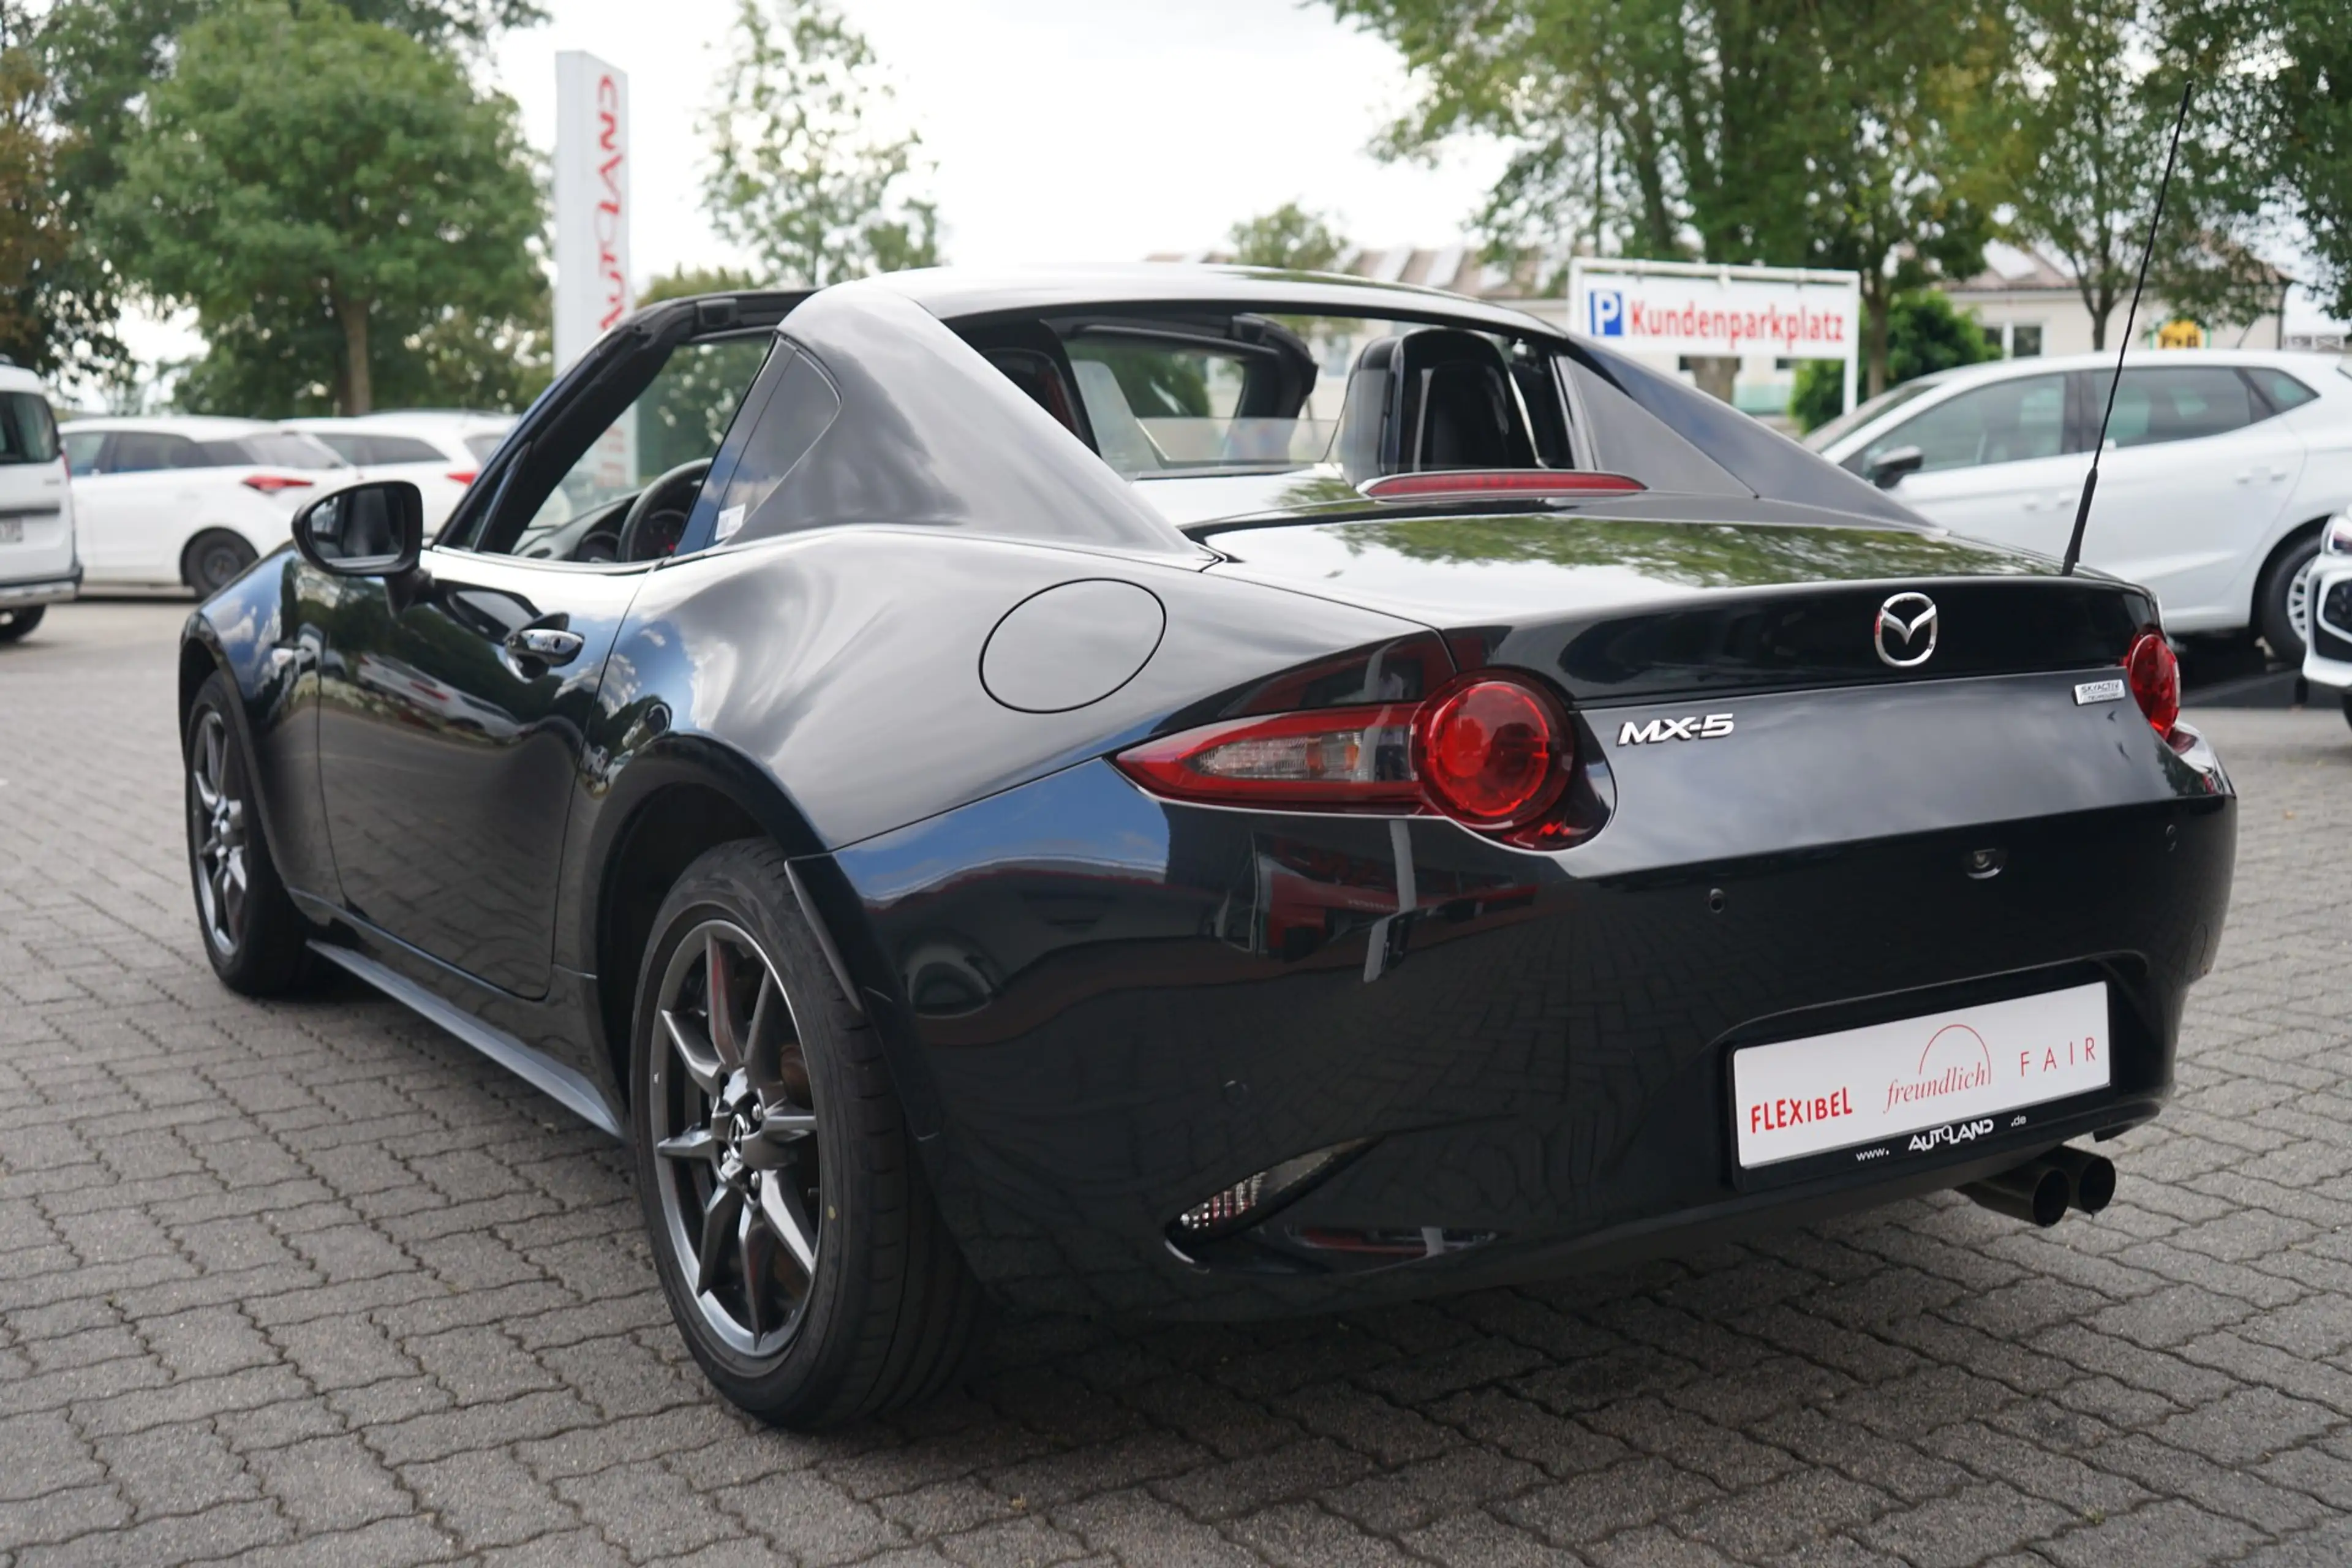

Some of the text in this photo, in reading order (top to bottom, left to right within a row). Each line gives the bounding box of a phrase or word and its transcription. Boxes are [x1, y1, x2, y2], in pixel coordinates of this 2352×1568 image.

[1630, 301, 1844, 349] Kundenparkplatz
[1618, 713, 1734, 745] MX-5
[1751, 1038, 2095, 1134] FLEXIBEL freundlich FAIR
[1855, 1115, 2027, 1161] www. AUTOLAND .de
